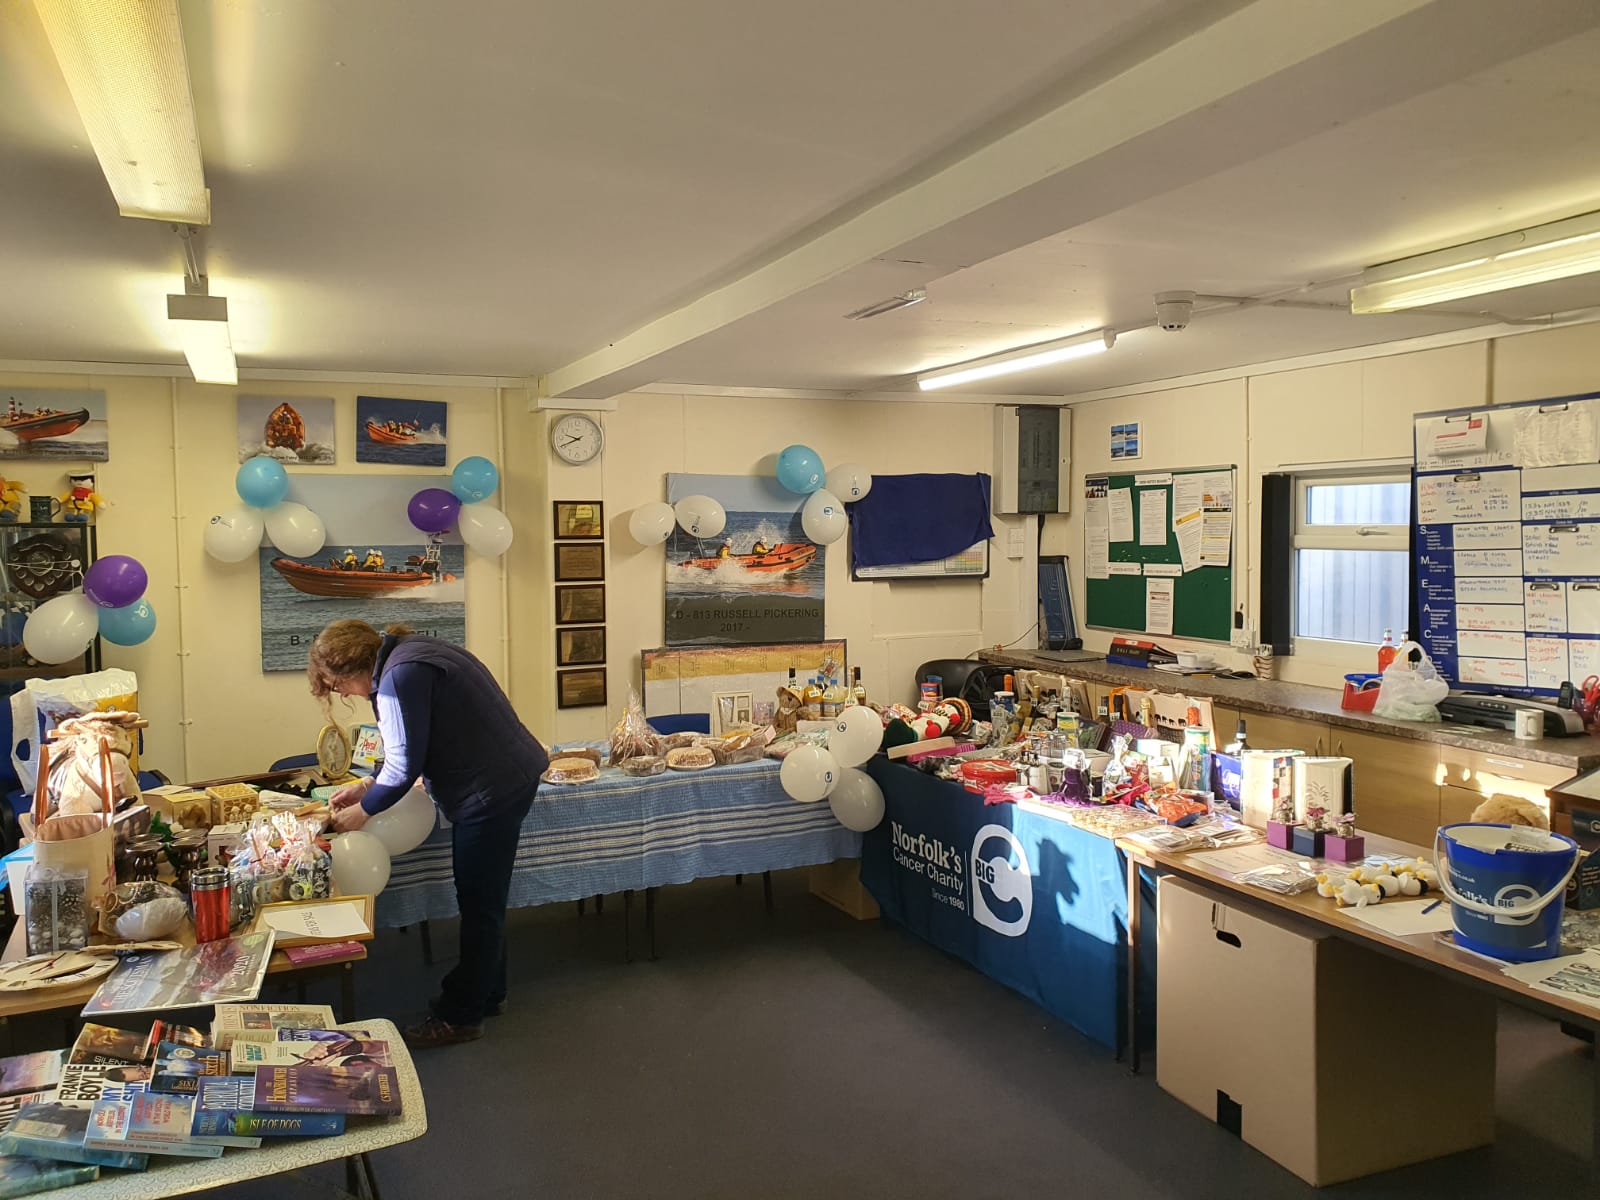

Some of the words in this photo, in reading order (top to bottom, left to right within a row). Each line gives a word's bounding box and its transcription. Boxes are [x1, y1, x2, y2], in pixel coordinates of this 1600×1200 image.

[693, 610, 710, 619] 813
[713, 609, 760, 619] RUSSELL
[764, 608, 819, 618] PICKERING
[720, 623, 743, 632] 2017
[891, 821, 962, 874] Norfolk's
[893, 847, 925, 874] Cancer
[927, 863, 964, 895] Charity
[975, 859, 995, 884] BIG
[1497, 899, 1515, 908] BIG
[59, 1065, 83, 1100] FRANKIE
[77, 1065, 107, 1101] BOYLE
[102, 1086, 121, 1102] MY
[202, 1081, 239, 1110] PATRICIA
[250, 1119, 268, 1129] ISLE
[280, 1119, 302, 1129] DOGS
